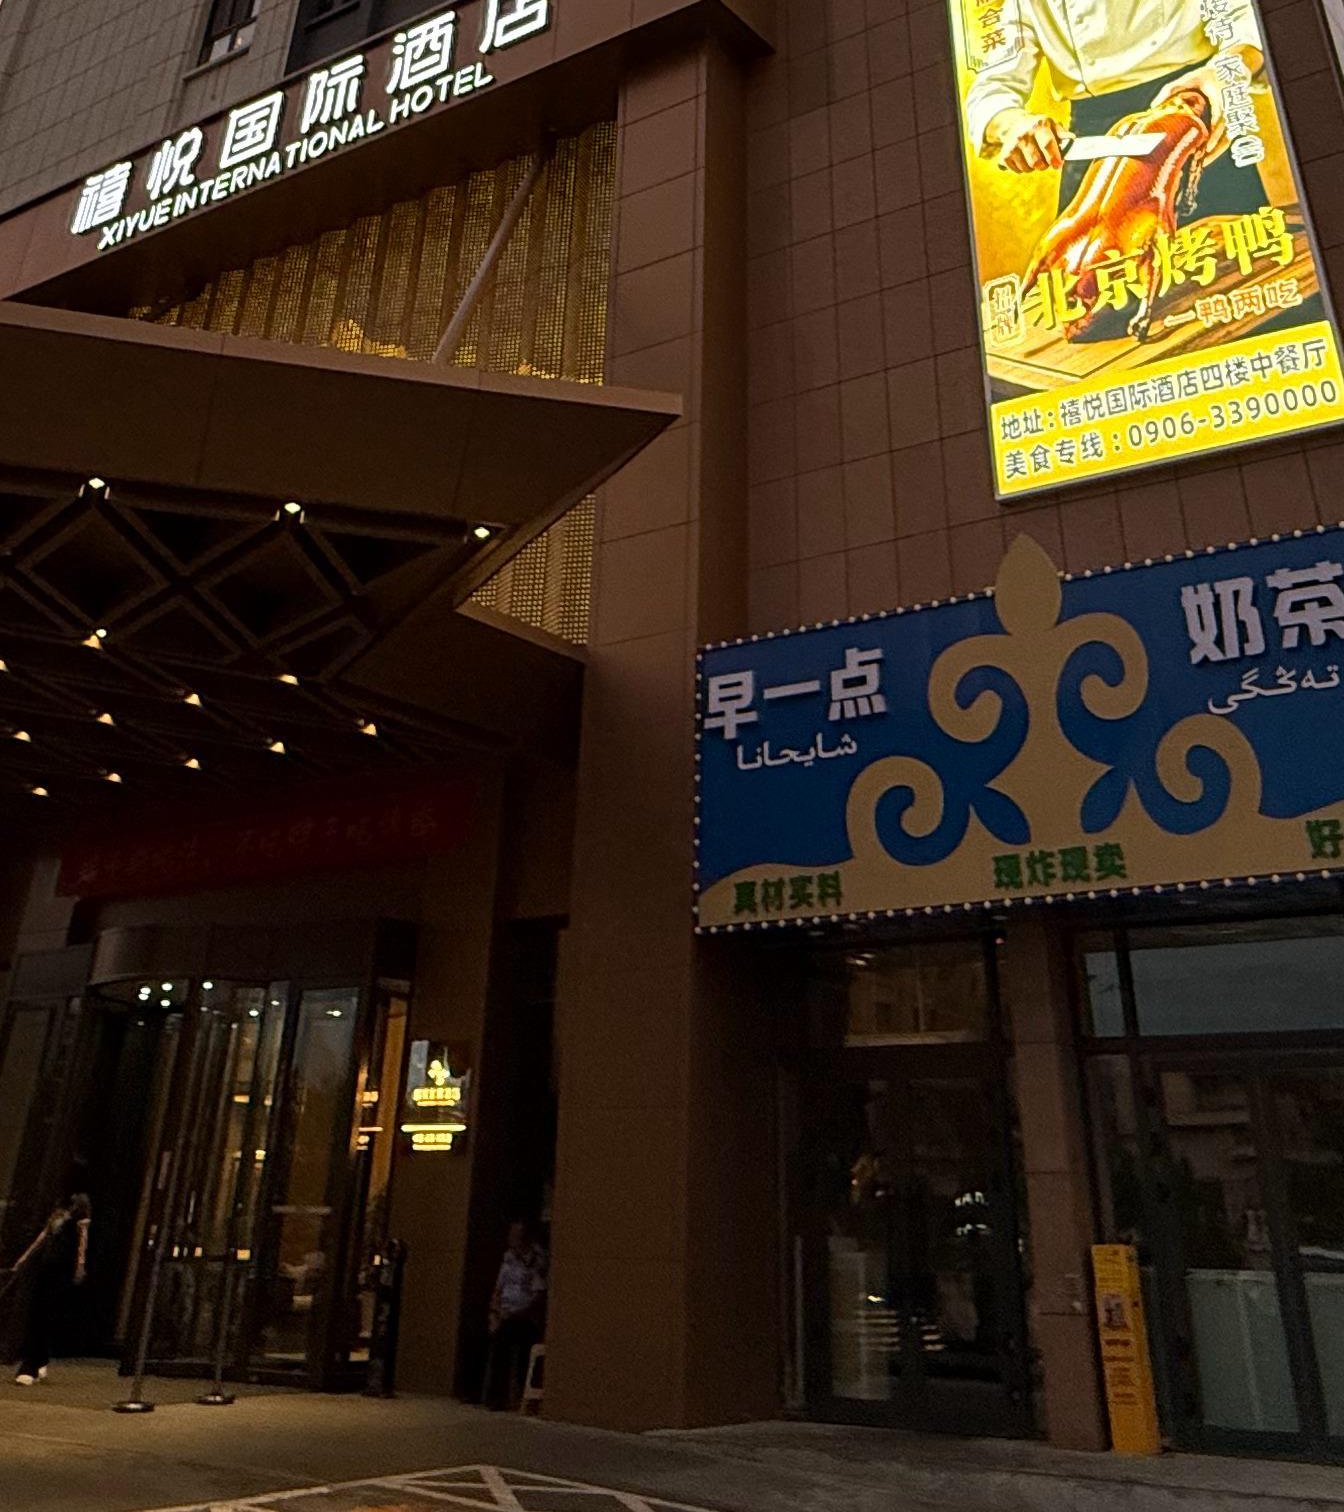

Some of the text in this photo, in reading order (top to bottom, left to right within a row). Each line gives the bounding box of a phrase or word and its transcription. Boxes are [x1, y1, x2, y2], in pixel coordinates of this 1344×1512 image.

[97, 61, 493, 250] XIYUE INTERNATIONAL HOTEL
[1021, 206, 1295, 331] 北京烤鸭
[1164, 280, 1303, 329] 一鸭两吃
[704, 647, 887, 740] 早一点
